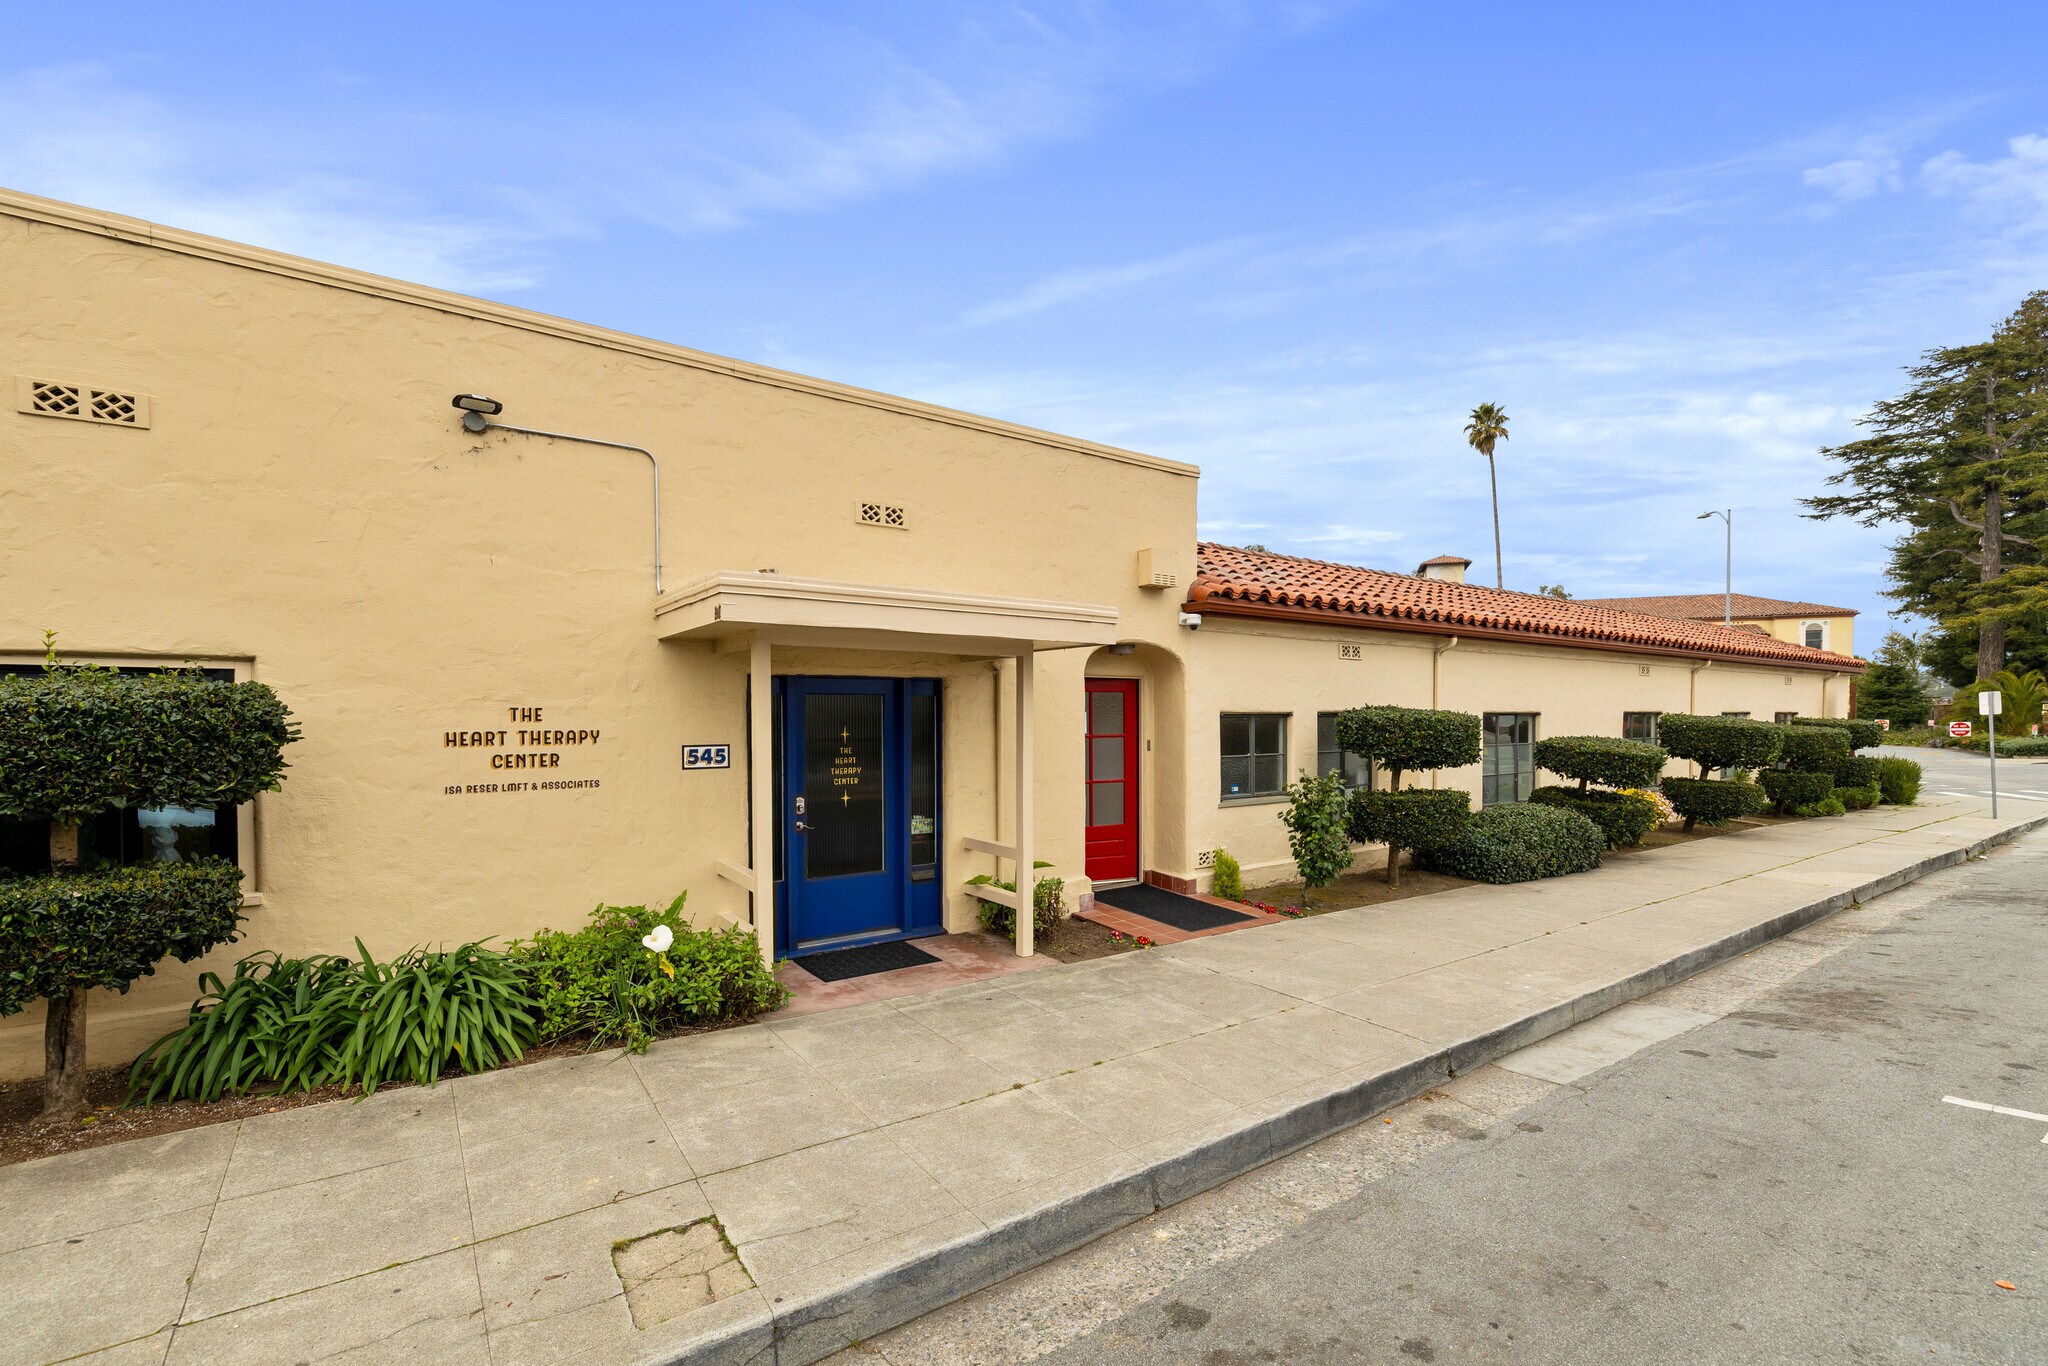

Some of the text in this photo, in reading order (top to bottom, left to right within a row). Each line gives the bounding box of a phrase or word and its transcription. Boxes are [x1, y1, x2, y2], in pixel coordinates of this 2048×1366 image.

[508, 707, 543, 723] THE
[444, 729, 600, 748] HEART THERAPY
[490, 752, 560, 770] CENTER
[686, 748, 727, 766] 545
[834, 756, 857, 765] HEART
[830, 766, 862, 775] THERAPY
[445, 779, 600, 795] ISA RESER LMFT & ASSOCIATES
[833, 777, 859, 786] CENTER
